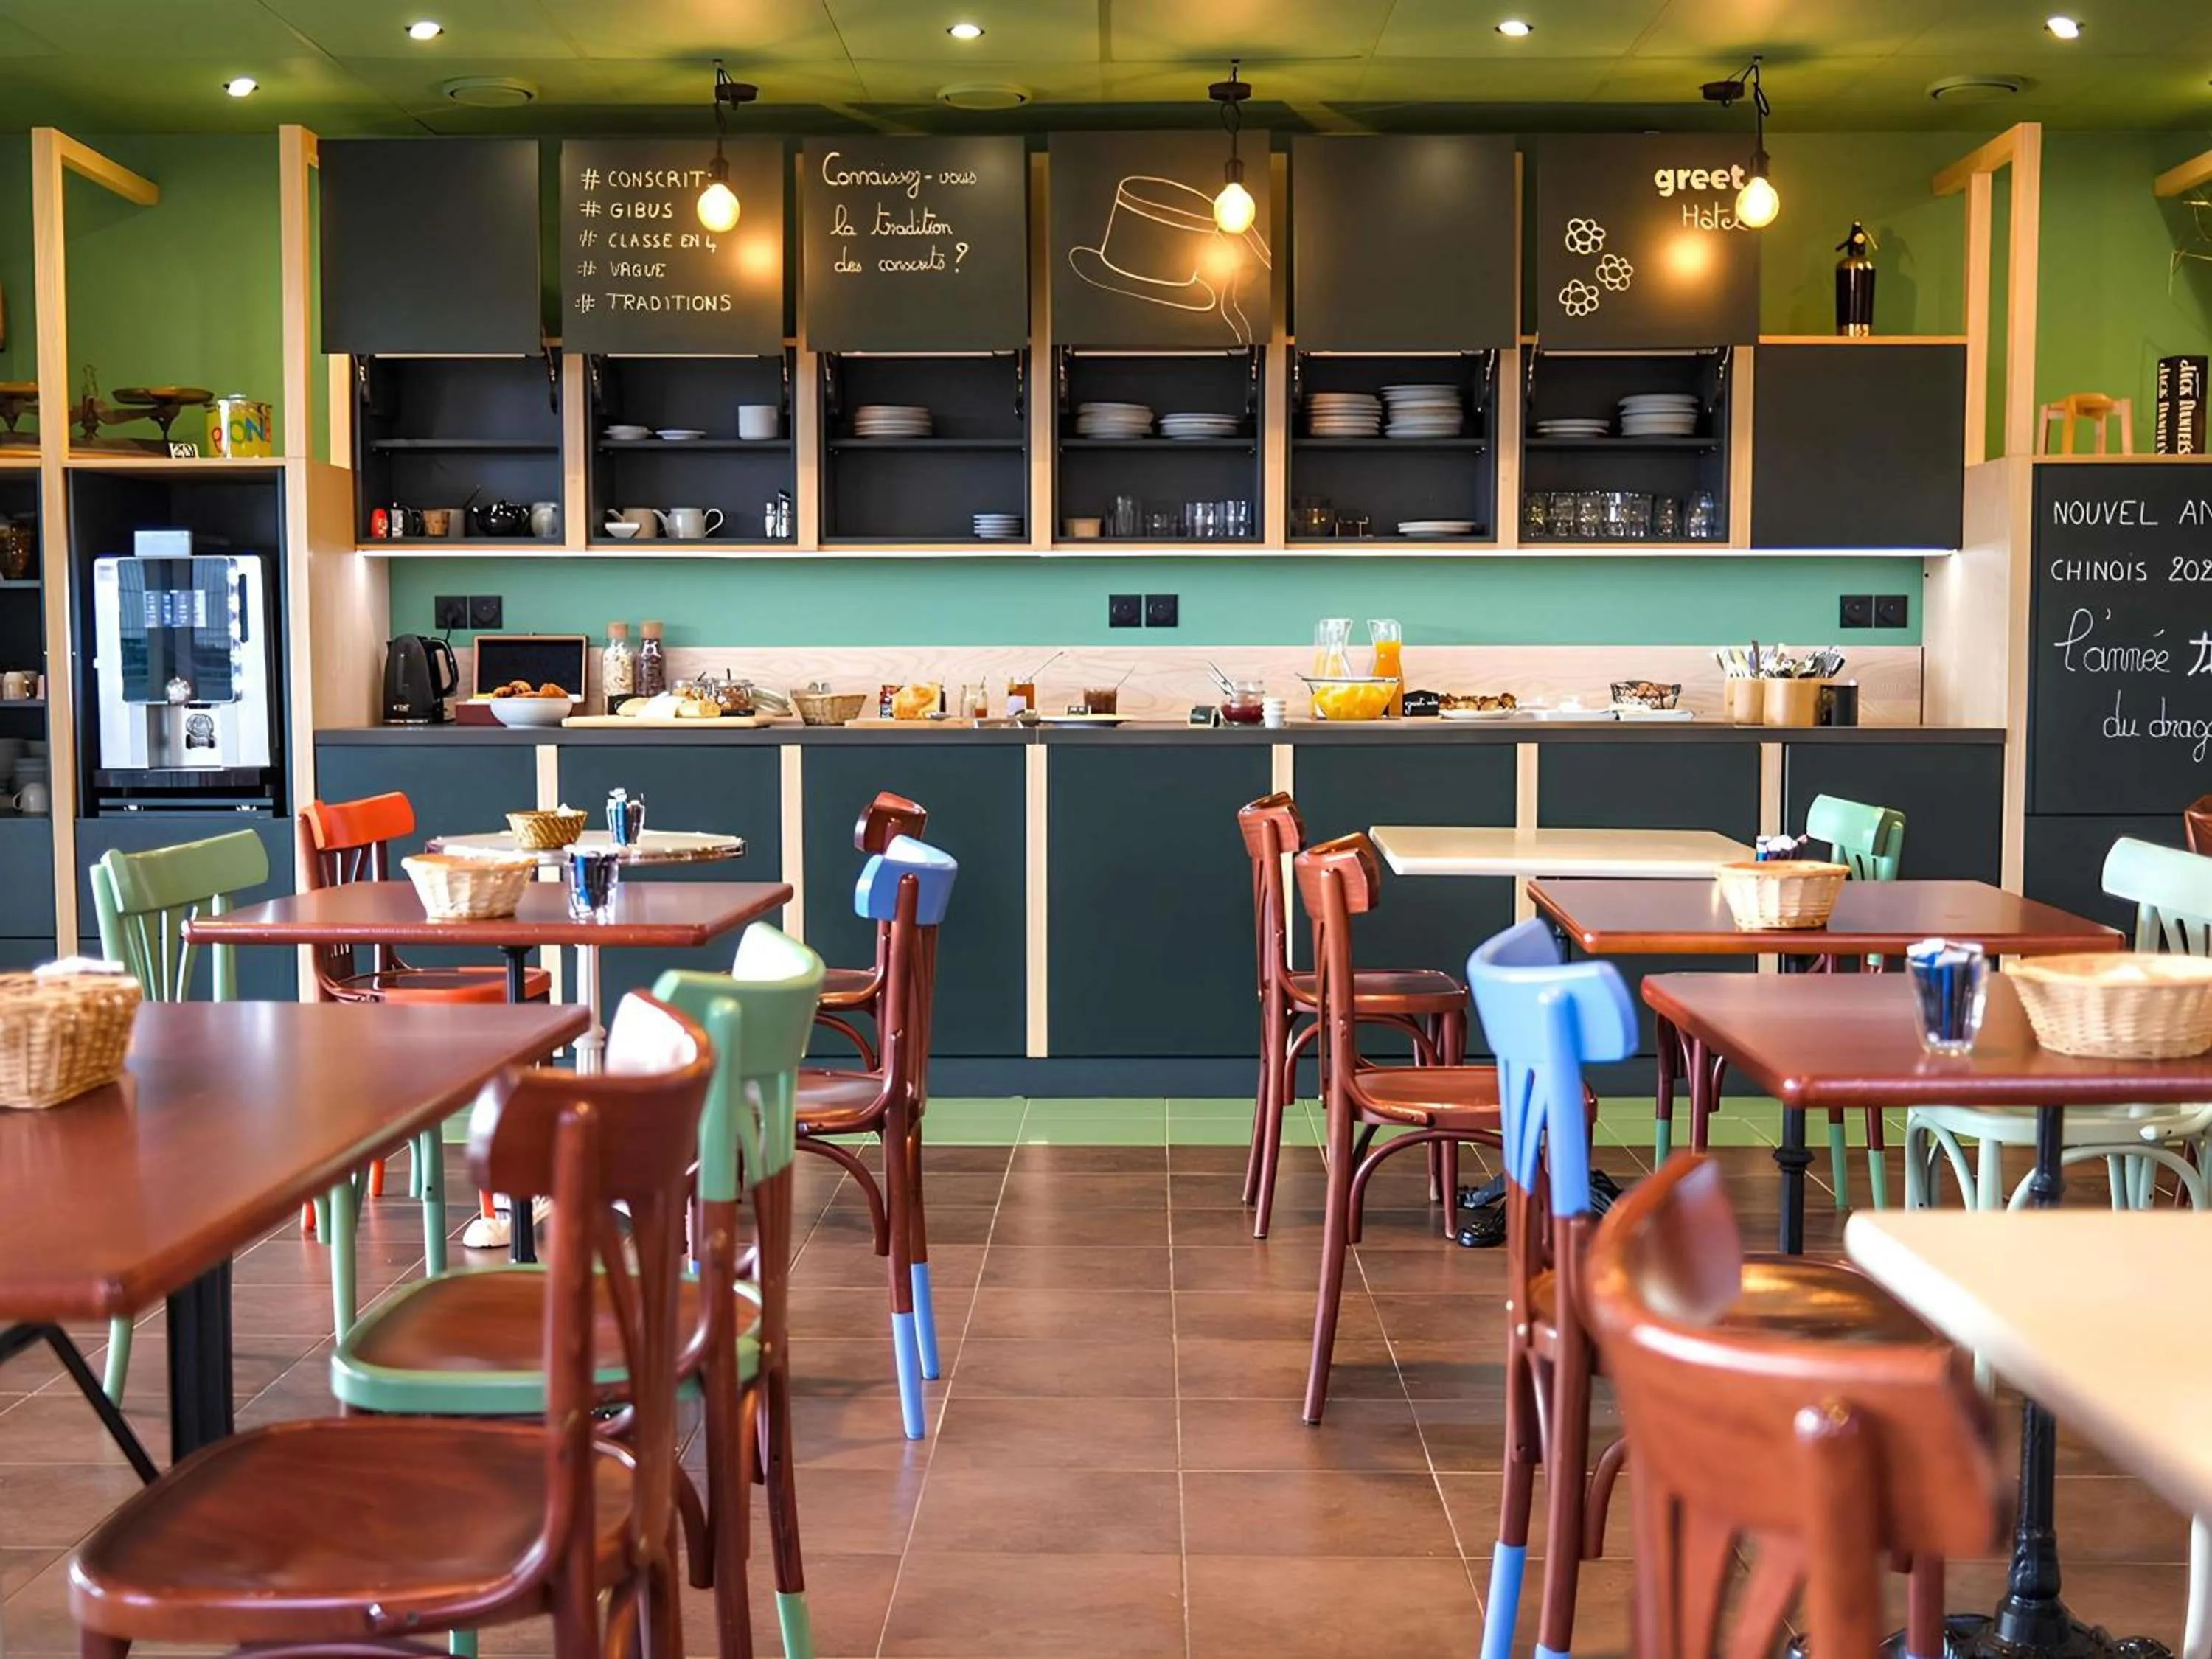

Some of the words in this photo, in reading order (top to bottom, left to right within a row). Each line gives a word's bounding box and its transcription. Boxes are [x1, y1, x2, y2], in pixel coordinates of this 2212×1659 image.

[608, 170, 712, 189] CONSCRIT
[1654, 164, 1745, 197] greet
[610, 201, 673, 219] GIBUS
[830, 204, 858, 236] la
[870, 201, 953, 236] tradition
[608, 233, 672, 248] CLASSE
[681, 234, 700, 248] EN
[610, 261, 667, 278] VAGUE
[834, 245, 862, 272] des
[605, 293, 732, 312] TRADITIONS
[2054, 499, 2159, 525] NOUVEL
[2051, 558, 2149, 581] CHINOIS
[2053, 608, 2171, 673] l'année
[2103, 689, 2141, 738] du
